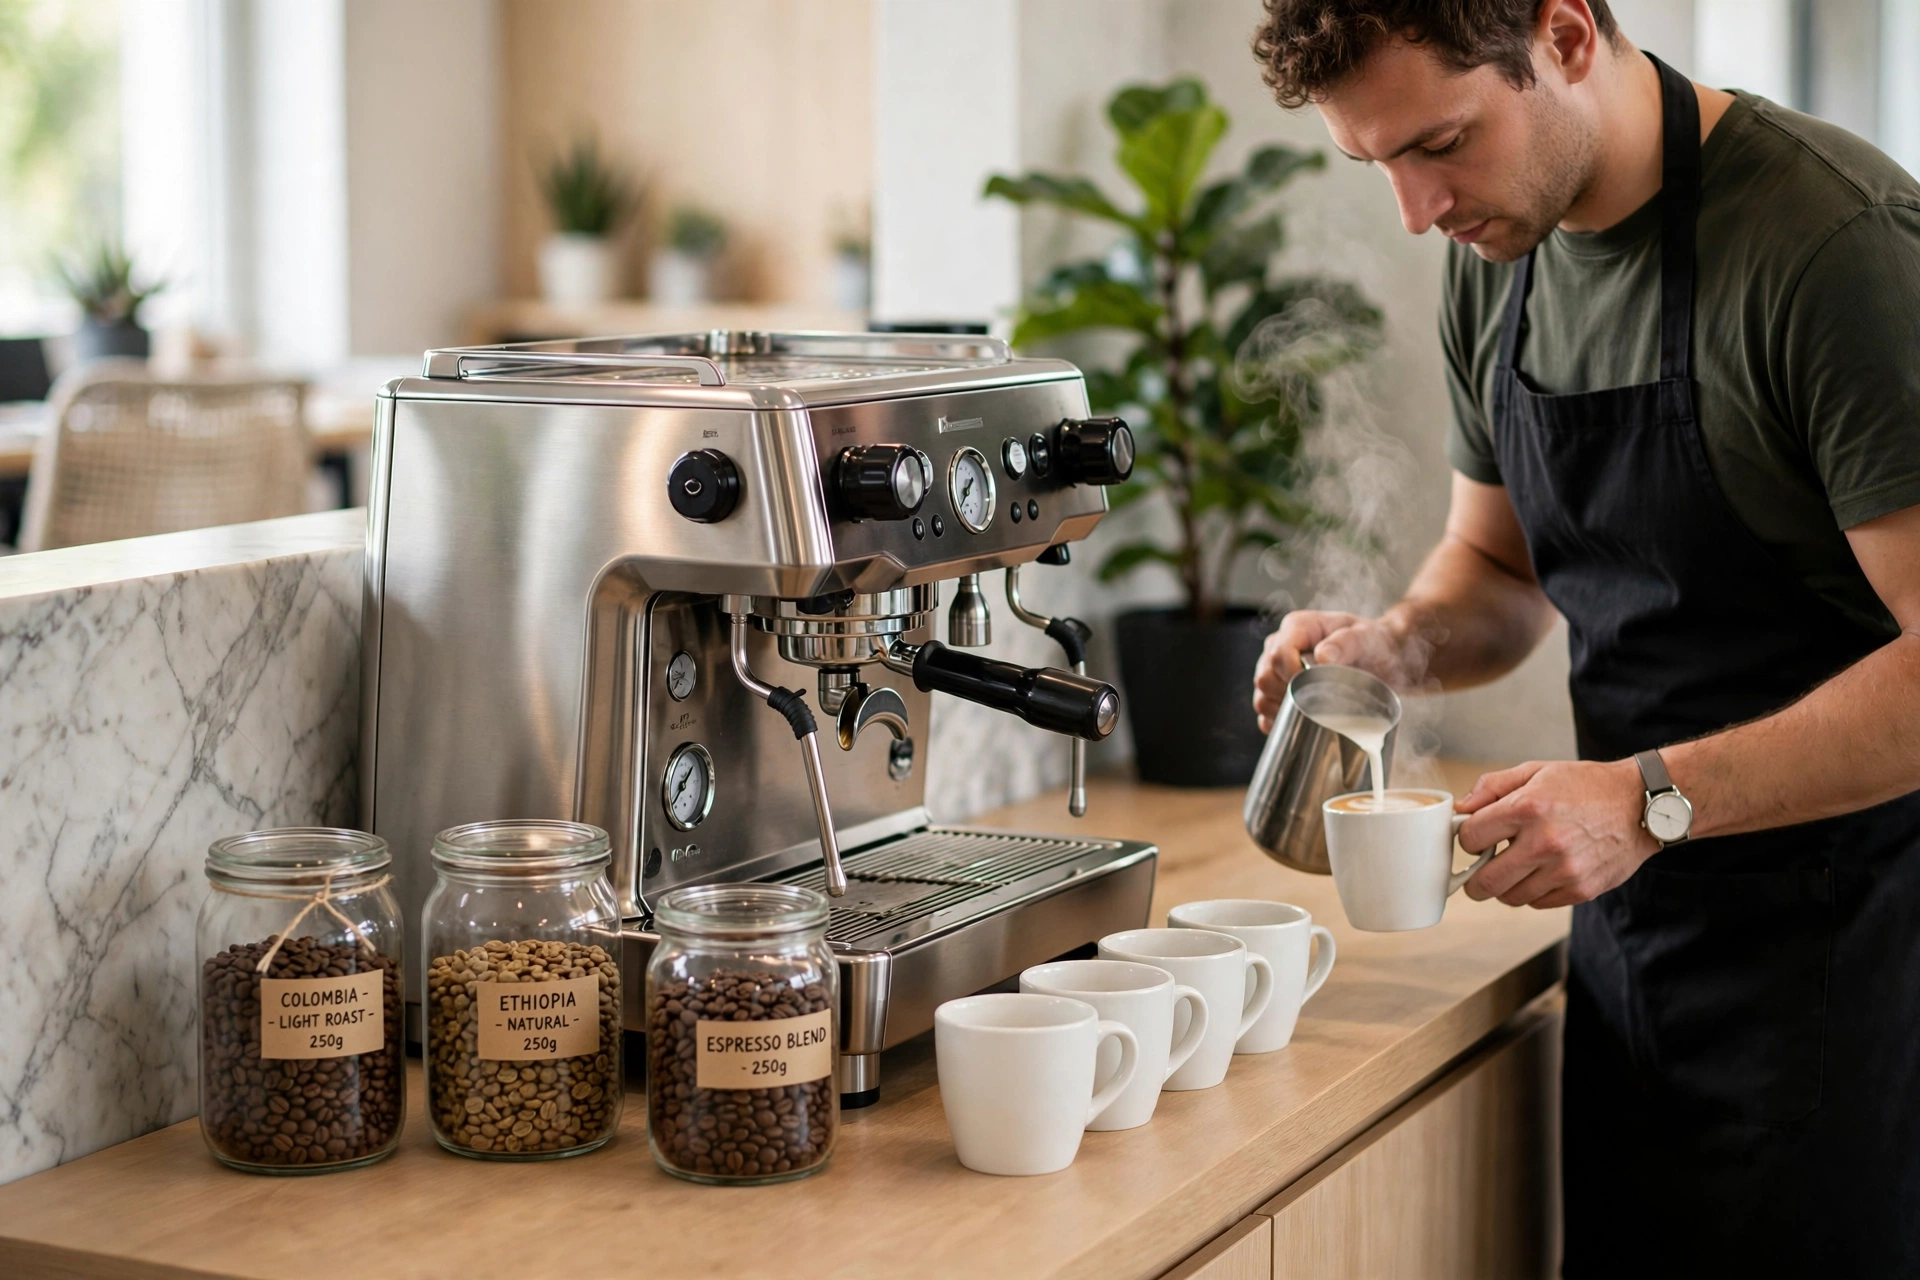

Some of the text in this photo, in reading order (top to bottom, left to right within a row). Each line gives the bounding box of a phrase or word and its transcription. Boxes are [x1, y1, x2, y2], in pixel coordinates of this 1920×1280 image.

[281, 987, 358, 1008] COLOMBIA
[500, 991, 576, 1012] ETHIOPIA
[279, 1013, 320, 1029] LIGHT
[325, 1009, 365, 1027] ROAST
[507, 1014, 570, 1031] NATURAL
[309, 1033, 343, 1050] 250g
[523, 1036, 557, 1053] 250g
[707, 1026, 827, 1053] ESPRESSO BLEND
[752, 1059, 787, 1076] 250g
